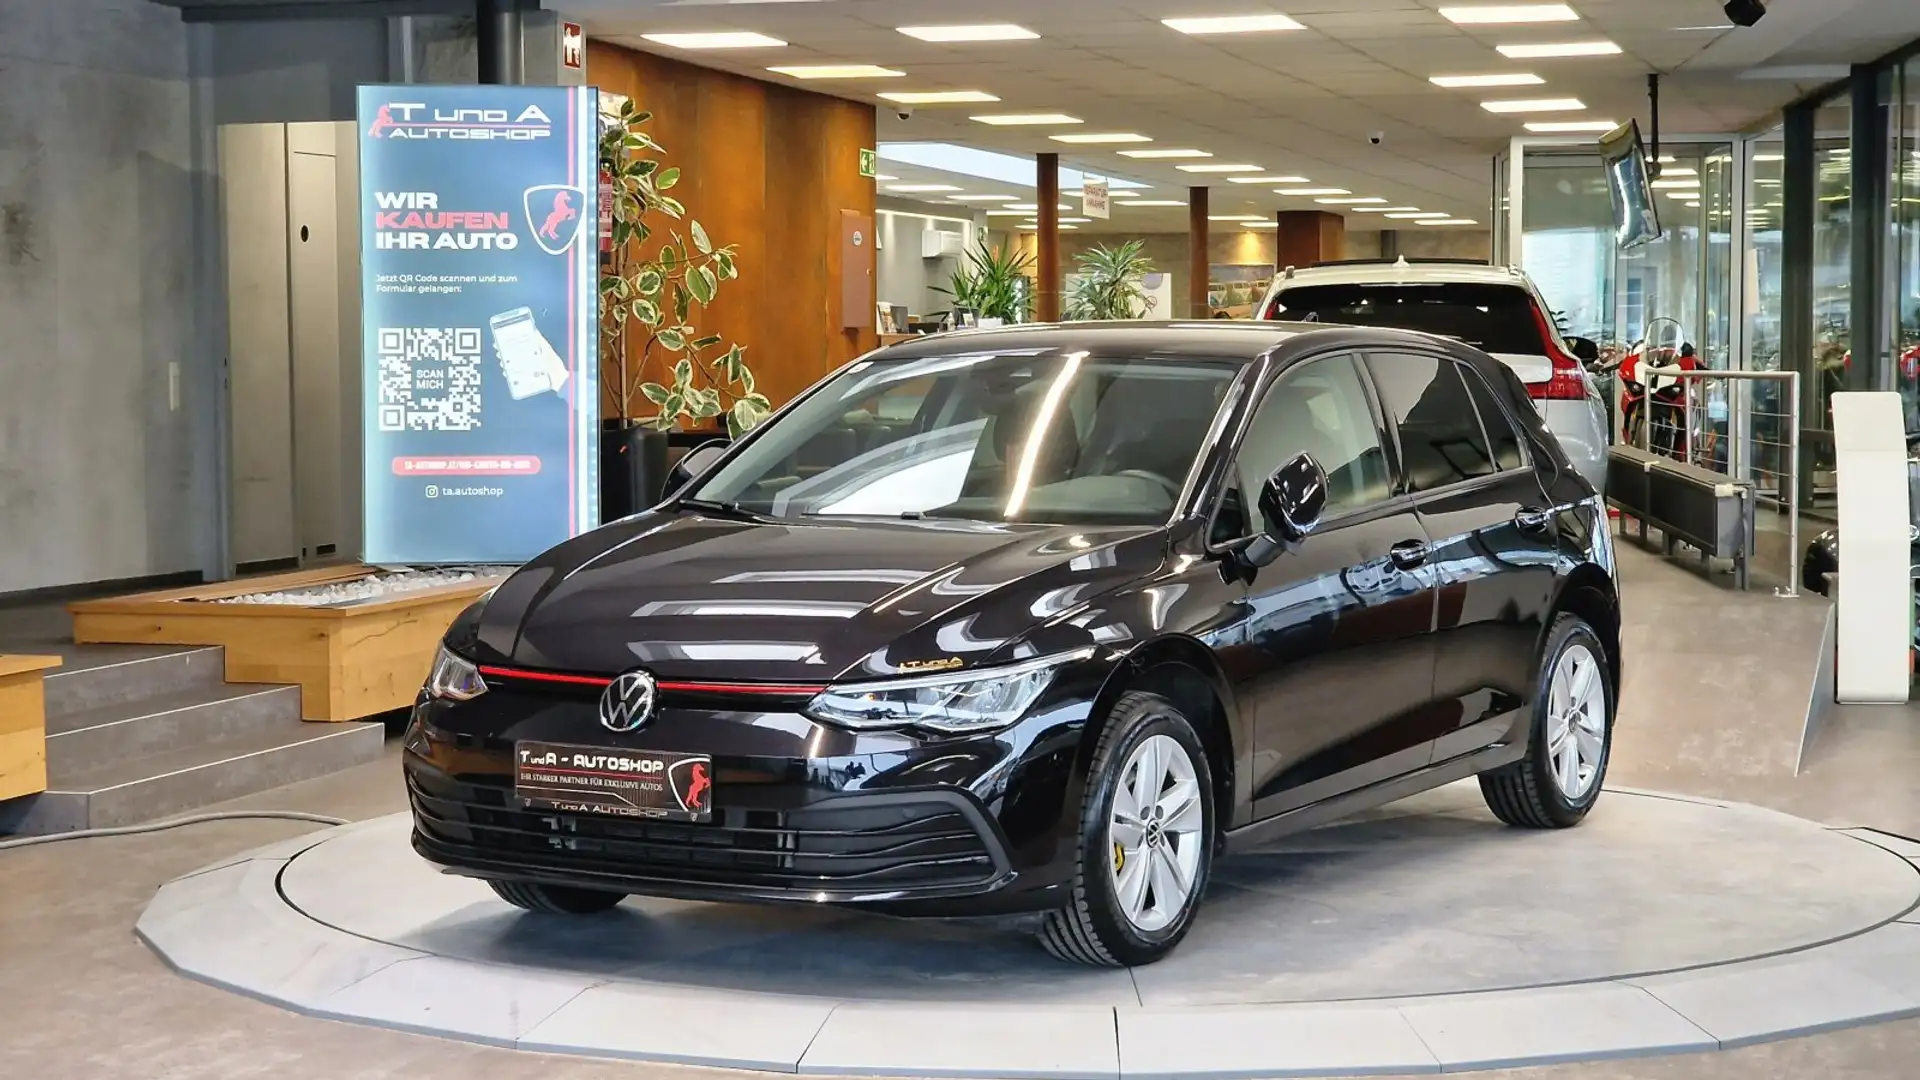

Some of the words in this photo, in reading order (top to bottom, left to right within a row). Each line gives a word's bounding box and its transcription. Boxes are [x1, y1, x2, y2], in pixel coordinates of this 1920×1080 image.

[389, 103, 425, 121] T
[515, 104, 551, 123] A
[389, 128, 551, 140] AUTOSHOP
[375, 192, 438, 209] WIR
[375, 212, 508, 229] KAUFEN
[375, 232, 430, 250] IHR
[433, 232, 518, 250] AUTO
[400, 275, 414, 283] QR
[415, 274, 438, 283] Code
[439, 275, 477, 283] scannen
[479, 274, 497, 283] und
[376, 285, 417, 293] Formular
[418, 285, 462, 294] gelangen:
[416, 370, 444, 379] SCAN
[416, 380, 444, 389] MICH
[442, 486, 504, 498] ta.autoshop
[573, 753, 664, 773] AUTOSHOP
[640, 783, 663, 791] AUTOS
[593, 805, 668, 818] AUTOSHOP
